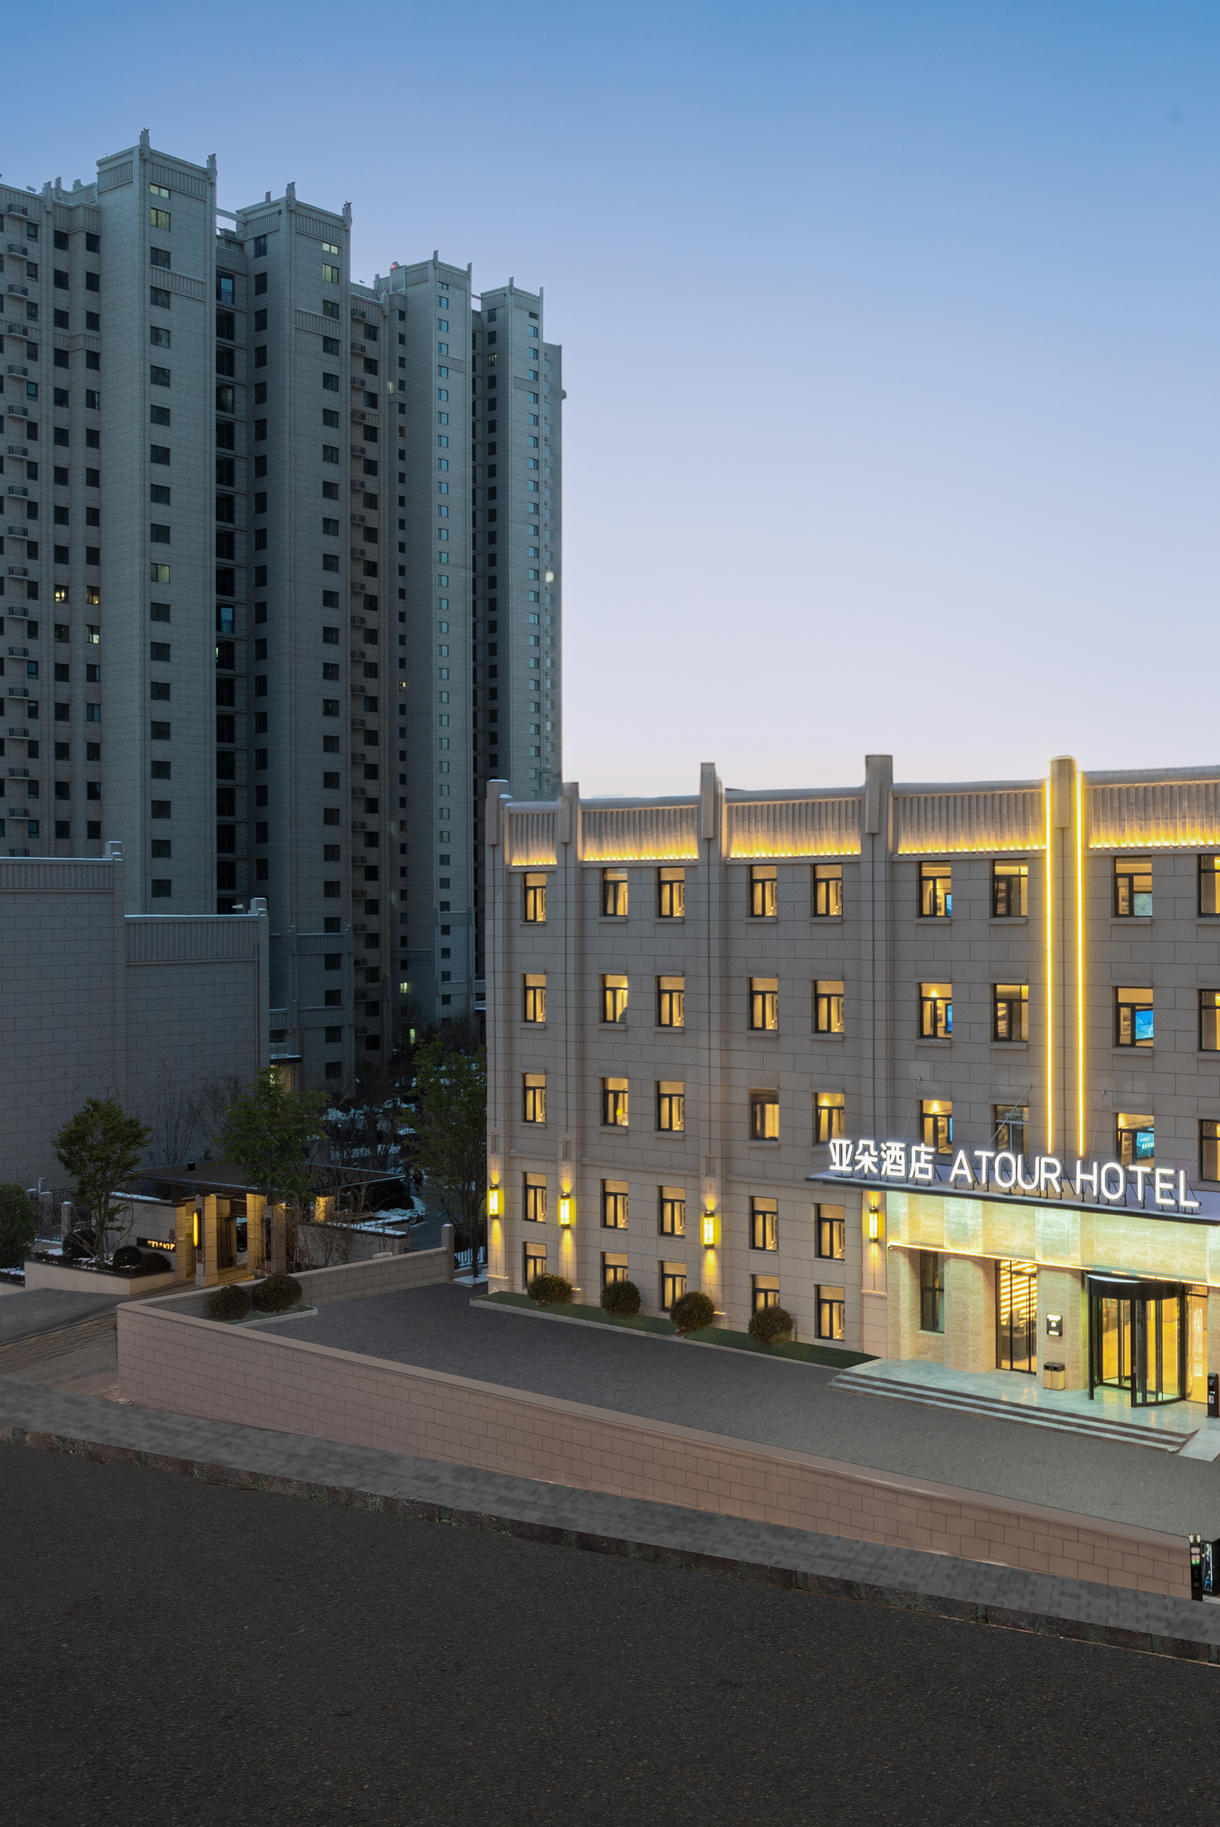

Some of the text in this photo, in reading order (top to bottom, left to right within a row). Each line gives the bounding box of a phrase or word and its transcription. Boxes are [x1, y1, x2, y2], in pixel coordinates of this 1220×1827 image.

[829, 1139, 1200, 1208] 亚朵酒店 ATOUR HOTEL
